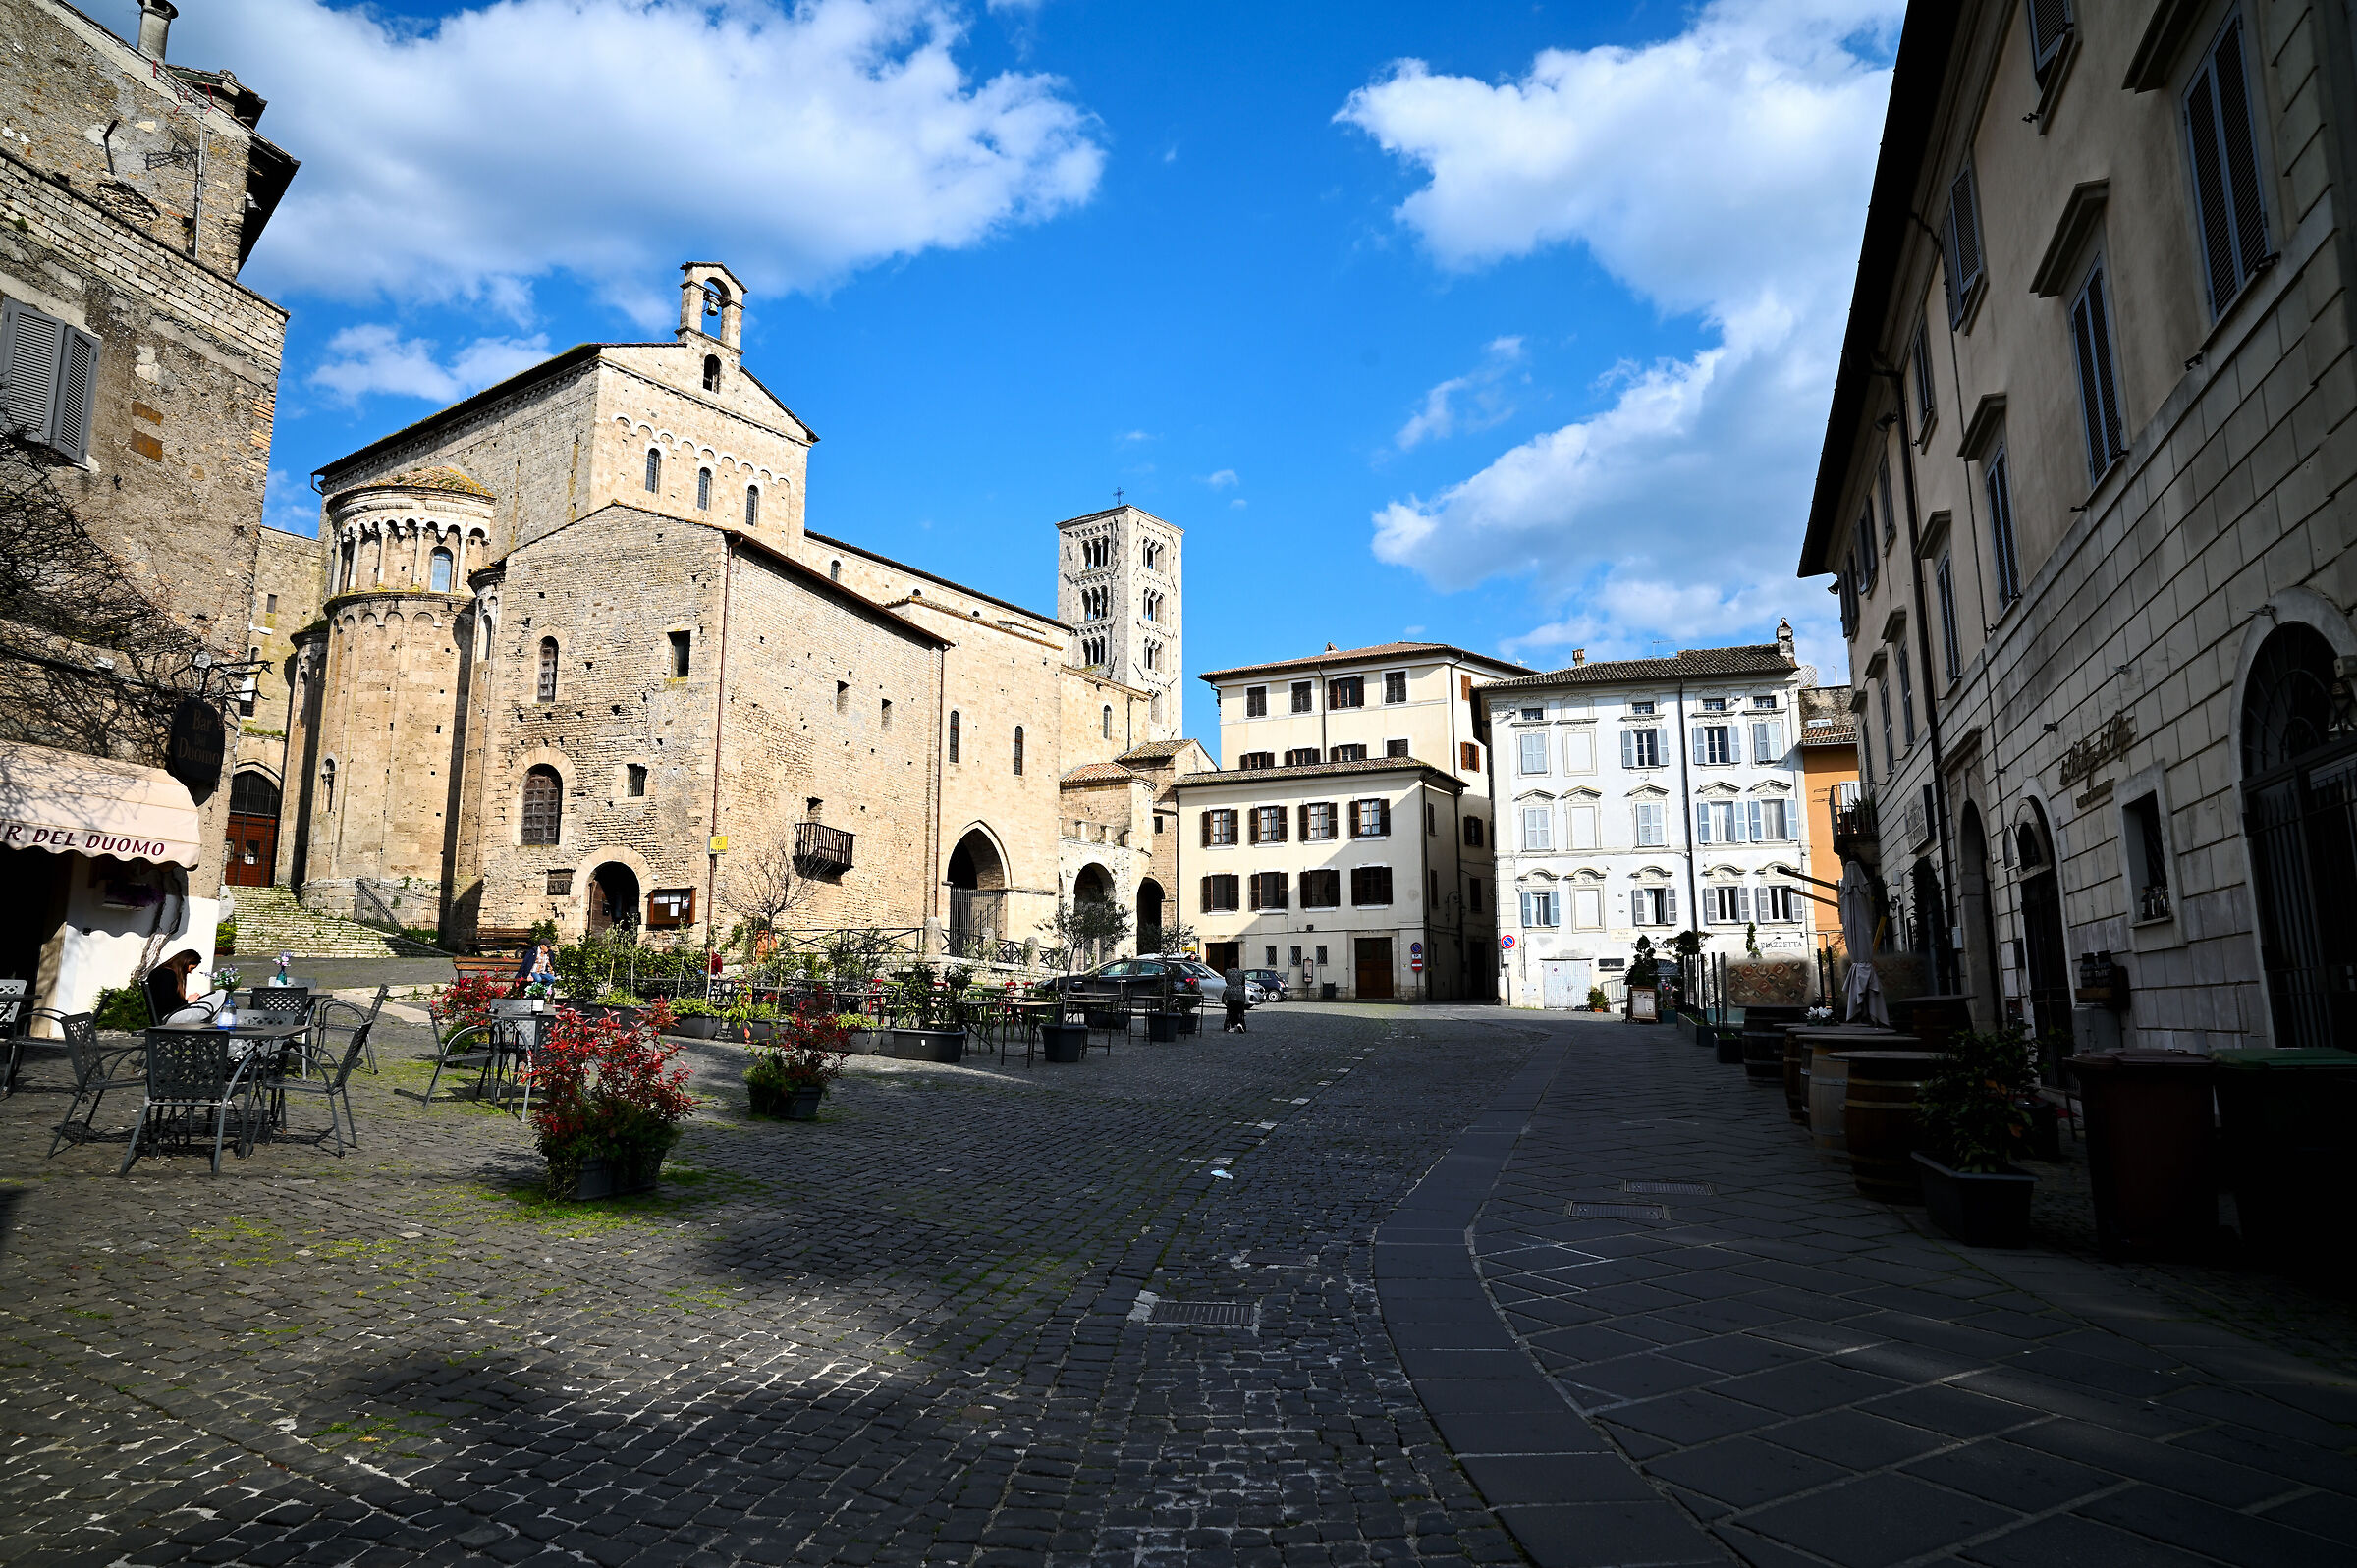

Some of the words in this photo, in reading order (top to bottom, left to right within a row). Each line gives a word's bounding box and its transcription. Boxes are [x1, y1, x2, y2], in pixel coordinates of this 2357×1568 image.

[192, 709, 213, 731] Bar
[177, 737, 221, 766] Duomo
[0, 823, 23, 841] R
[32, 828, 76, 846] DEL
[85, 835, 165, 856] DUOMO
